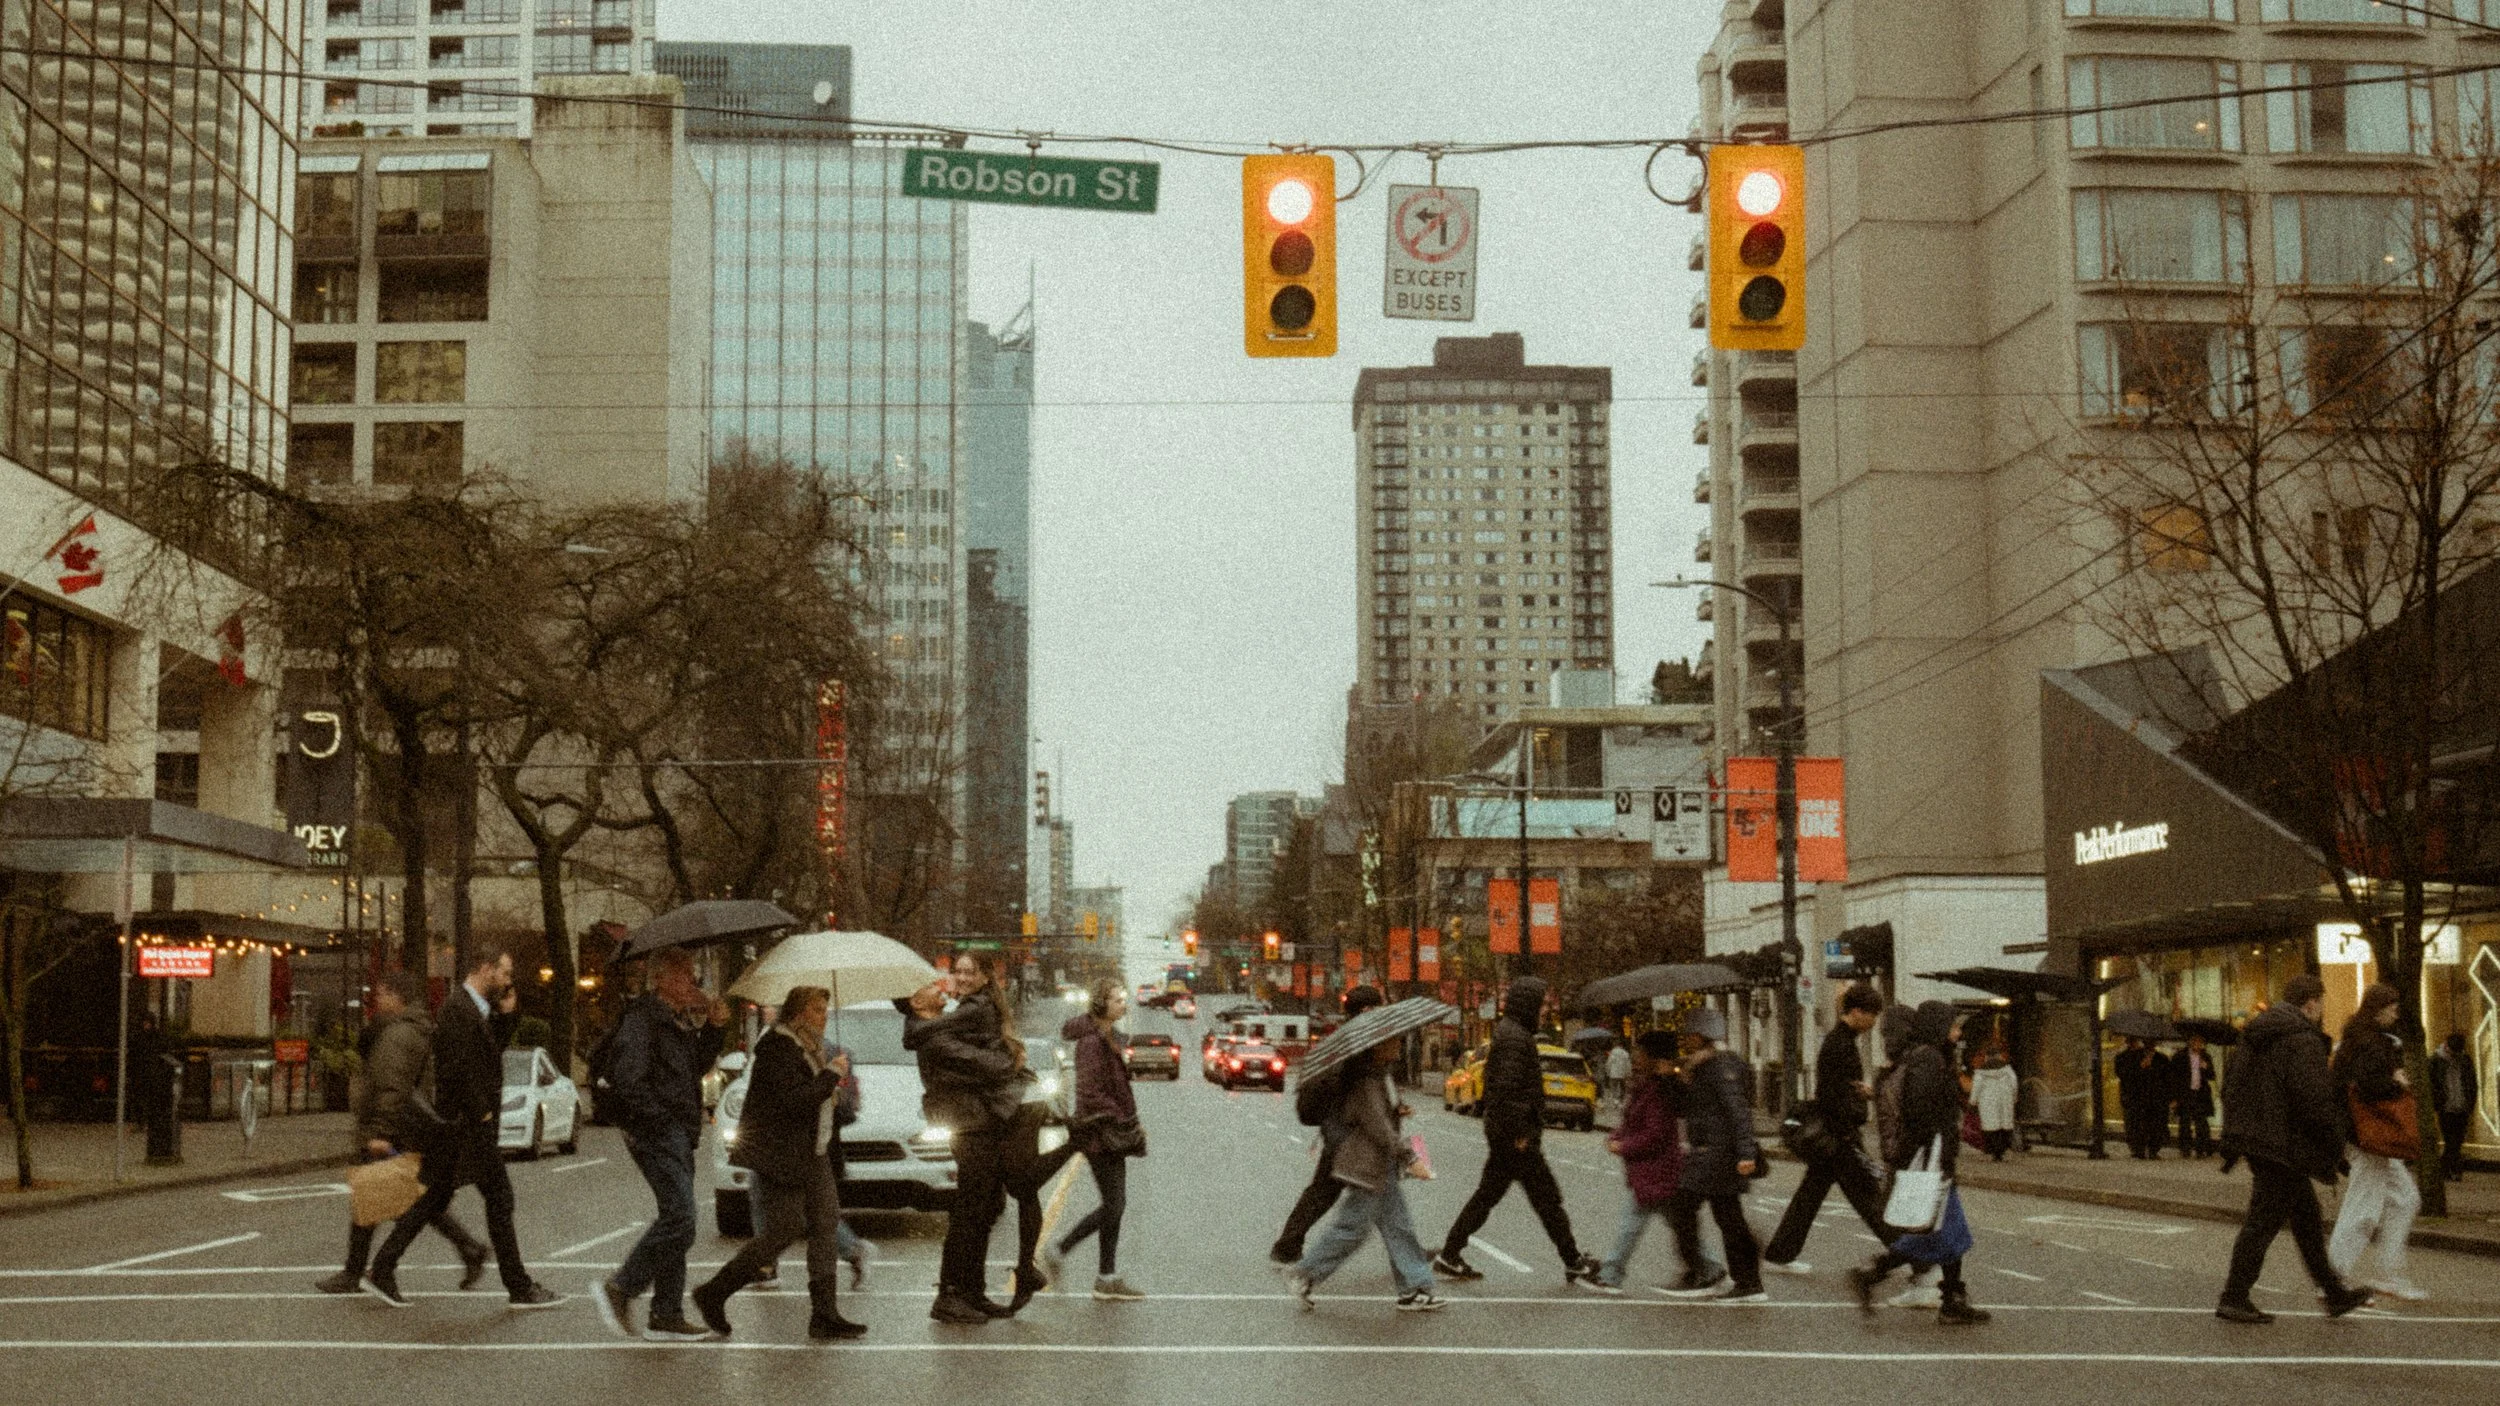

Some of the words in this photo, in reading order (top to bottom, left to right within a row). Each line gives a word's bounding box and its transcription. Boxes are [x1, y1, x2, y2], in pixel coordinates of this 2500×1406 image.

[920, 156, 1076, 197] Robson
[1096, 166, 1141, 201] St
[1394, 268, 1467, 288] EXCEPT
[1396, 292, 1461, 312] BUSES
[1800, 812, 1840, 837] ONE
